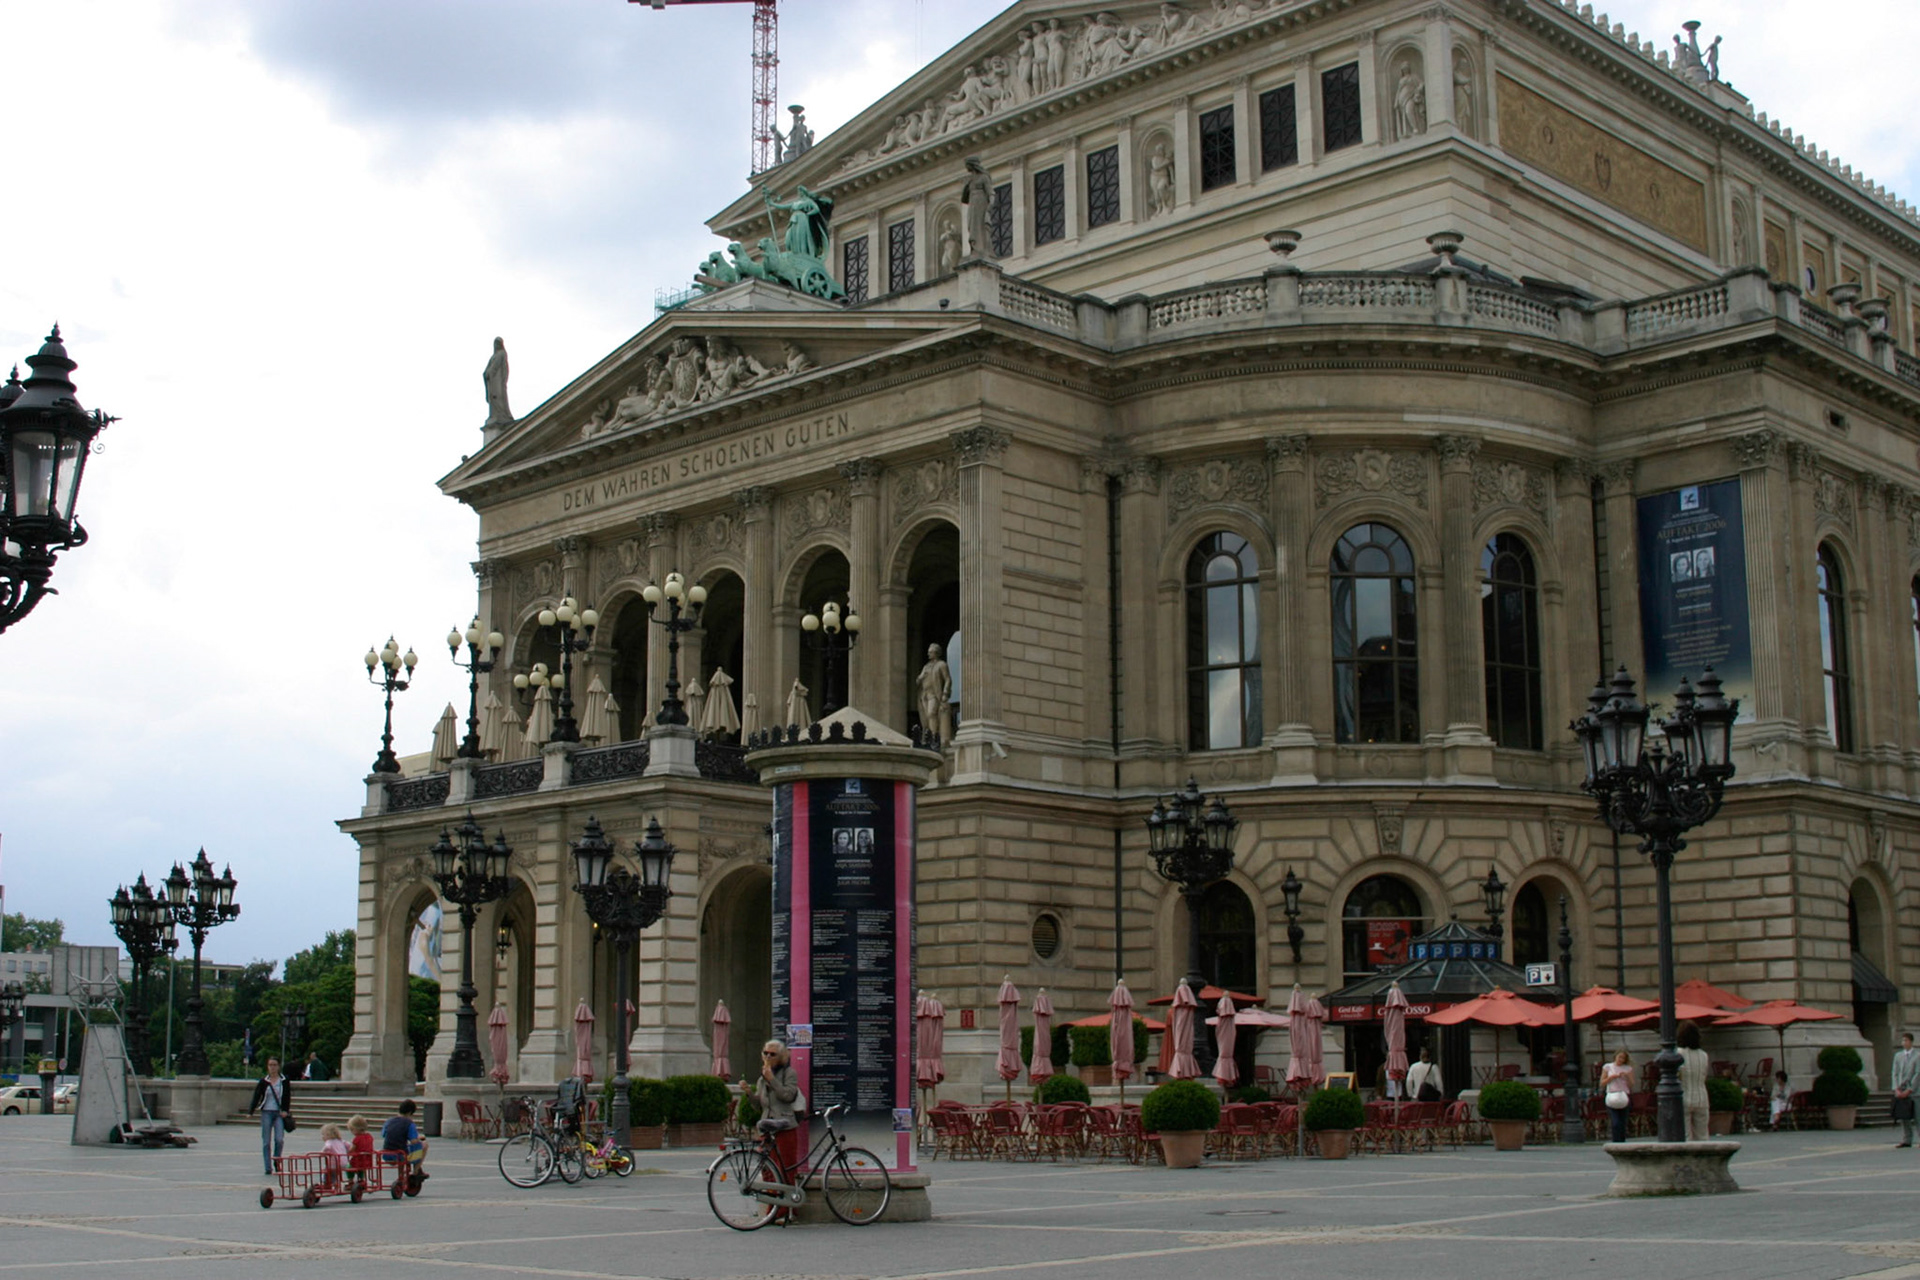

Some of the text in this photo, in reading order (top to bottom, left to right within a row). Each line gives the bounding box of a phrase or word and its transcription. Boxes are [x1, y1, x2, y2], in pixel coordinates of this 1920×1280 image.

[563, 412, 856, 511] DEM WAHREN SCHOENEN GUTEN.
[1433, 947, 1443, 959] P
[1453, 946, 1462, 958] P
[1472, 947, 1481, 958] P
[1530, 971, 1538, 983] P
